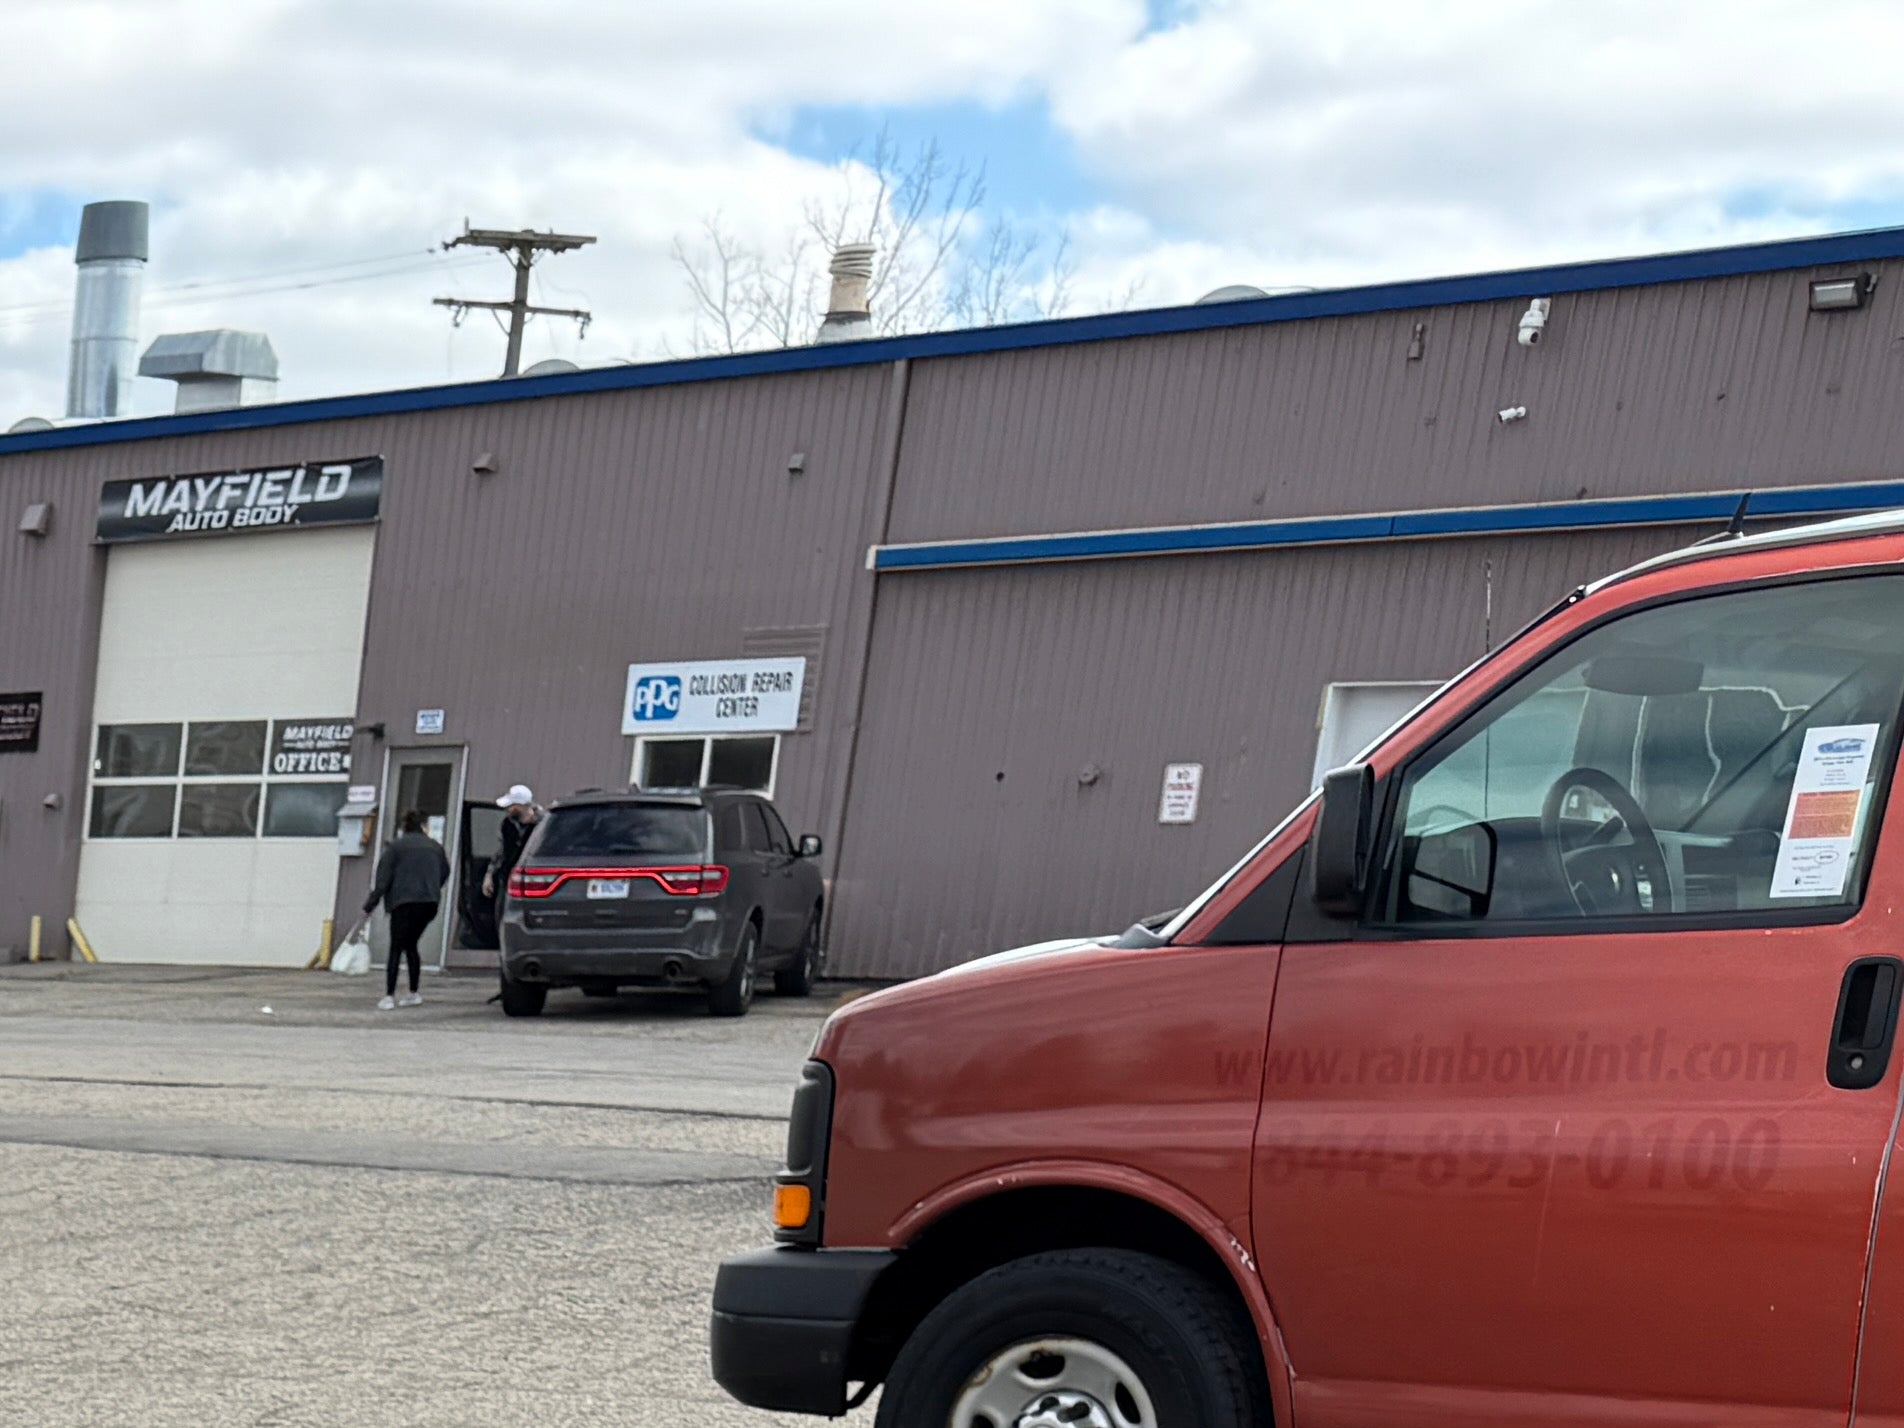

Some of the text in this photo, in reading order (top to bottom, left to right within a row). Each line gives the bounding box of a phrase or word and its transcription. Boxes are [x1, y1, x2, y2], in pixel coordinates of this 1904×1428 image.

[124, 464, 352, 518] MAYFIELD
[165, 503, 299, 534] AUTO BODY
[634, 679, 681, 719] PPG
[688, 671, 795, 696] COLLISION REPAIR
[715, 696, 760, 719] CENTER
[282, 724, 354, 741] MAYFIELD
[274, 752, 342, 773] OFFICE
[1212, 1028, 1798, 1087] www.rainbowintl.com
[1262, 1117, 1782, 1191] 844-893-0100
